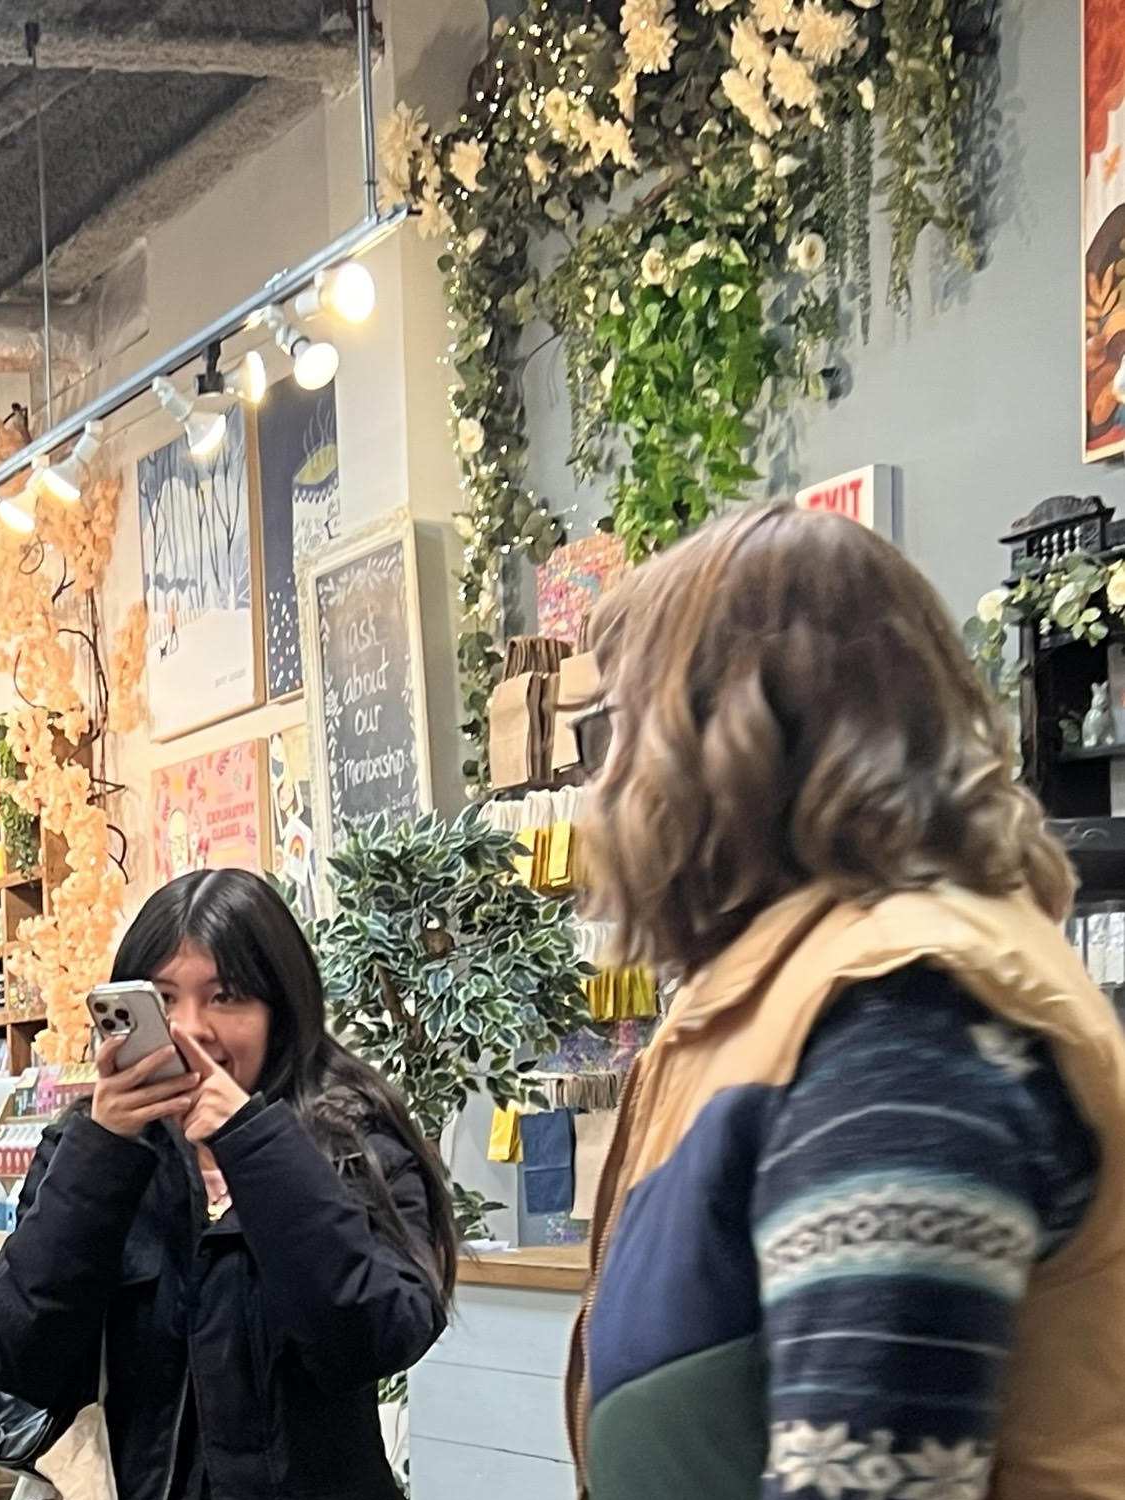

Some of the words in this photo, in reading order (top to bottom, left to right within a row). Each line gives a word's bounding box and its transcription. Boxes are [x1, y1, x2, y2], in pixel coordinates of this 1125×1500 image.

[348, 603, 379, 654] ask
[342, 647, 389, 705] about
[355, 704, 383, 736] our
